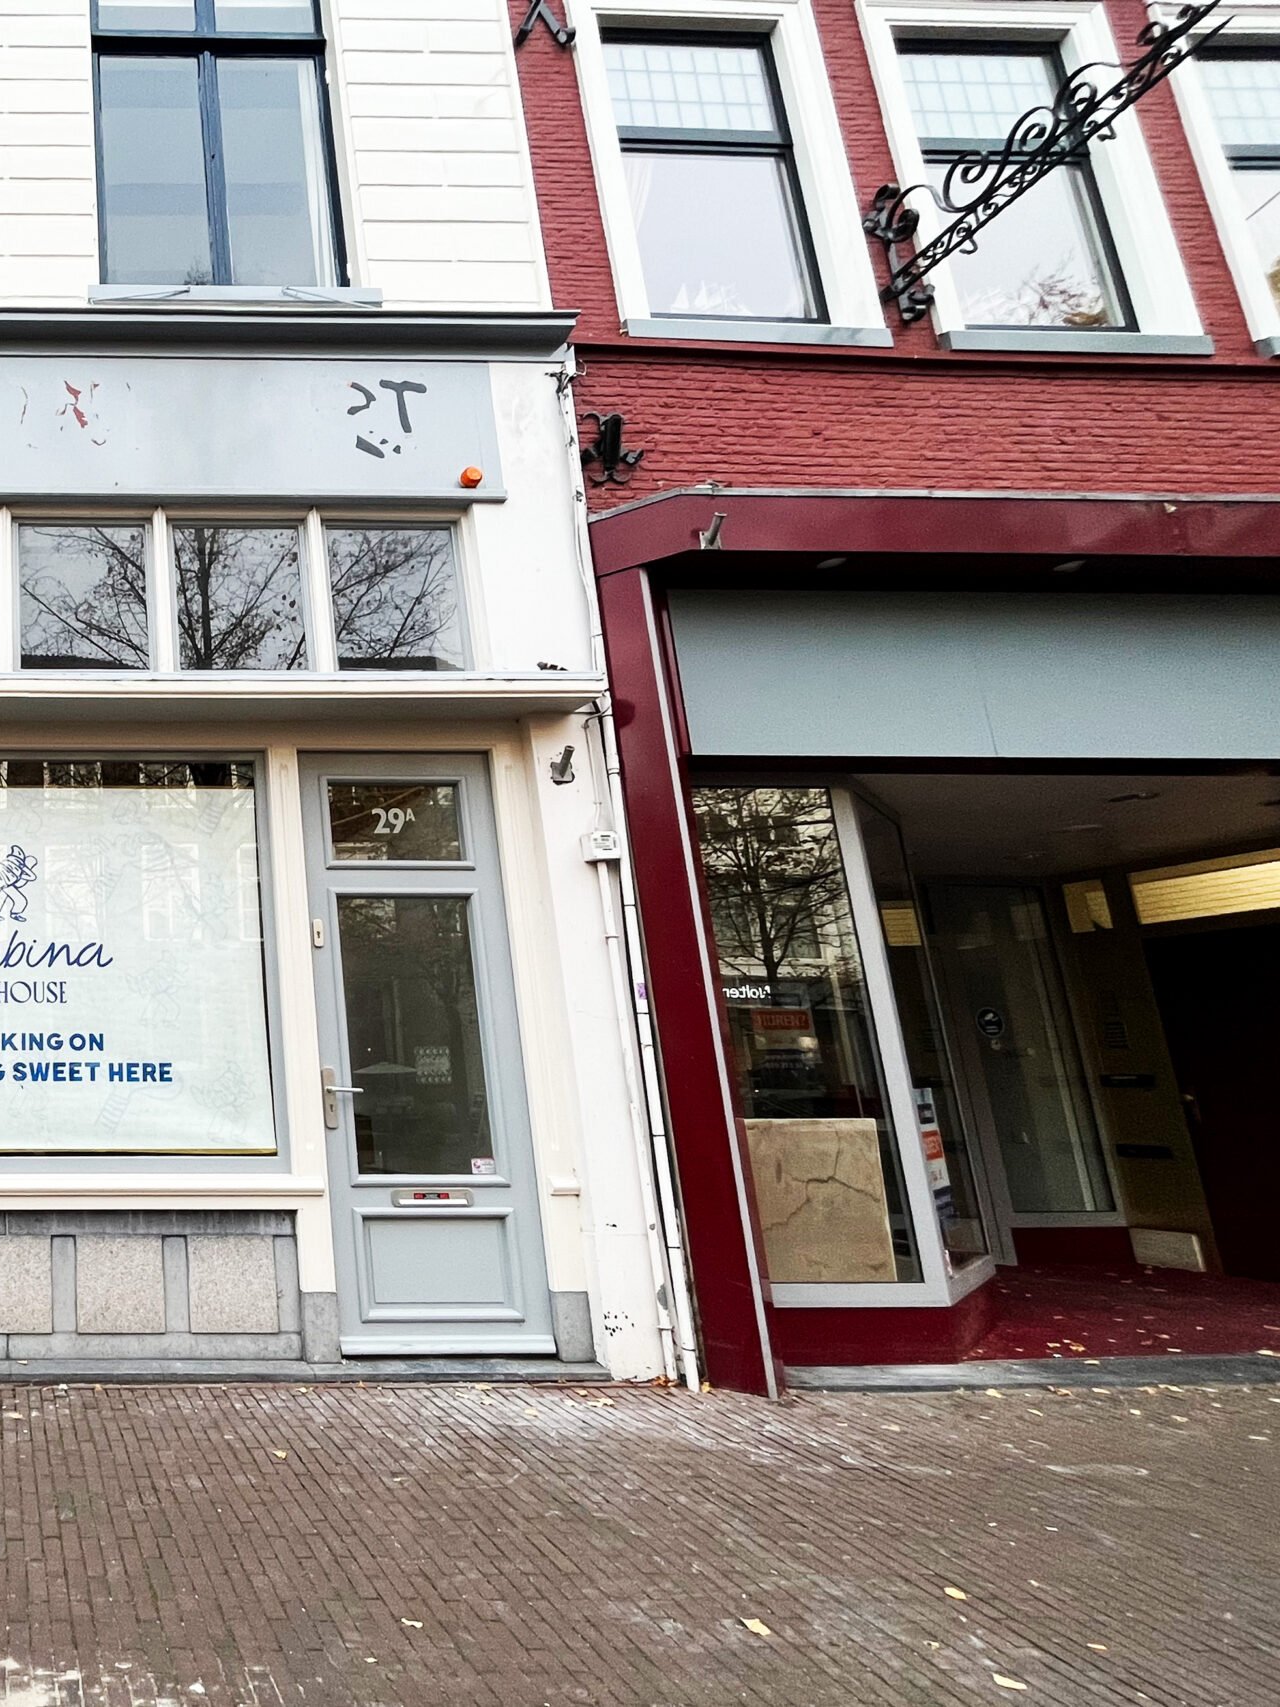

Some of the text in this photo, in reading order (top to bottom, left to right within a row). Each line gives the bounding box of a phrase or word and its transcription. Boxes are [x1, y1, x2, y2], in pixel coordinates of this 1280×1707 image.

[68, 1033, 104, 1051] ON
[12, 1062, 100, 1083] SWEET
[108, 1062, 173, 1083] HERE
